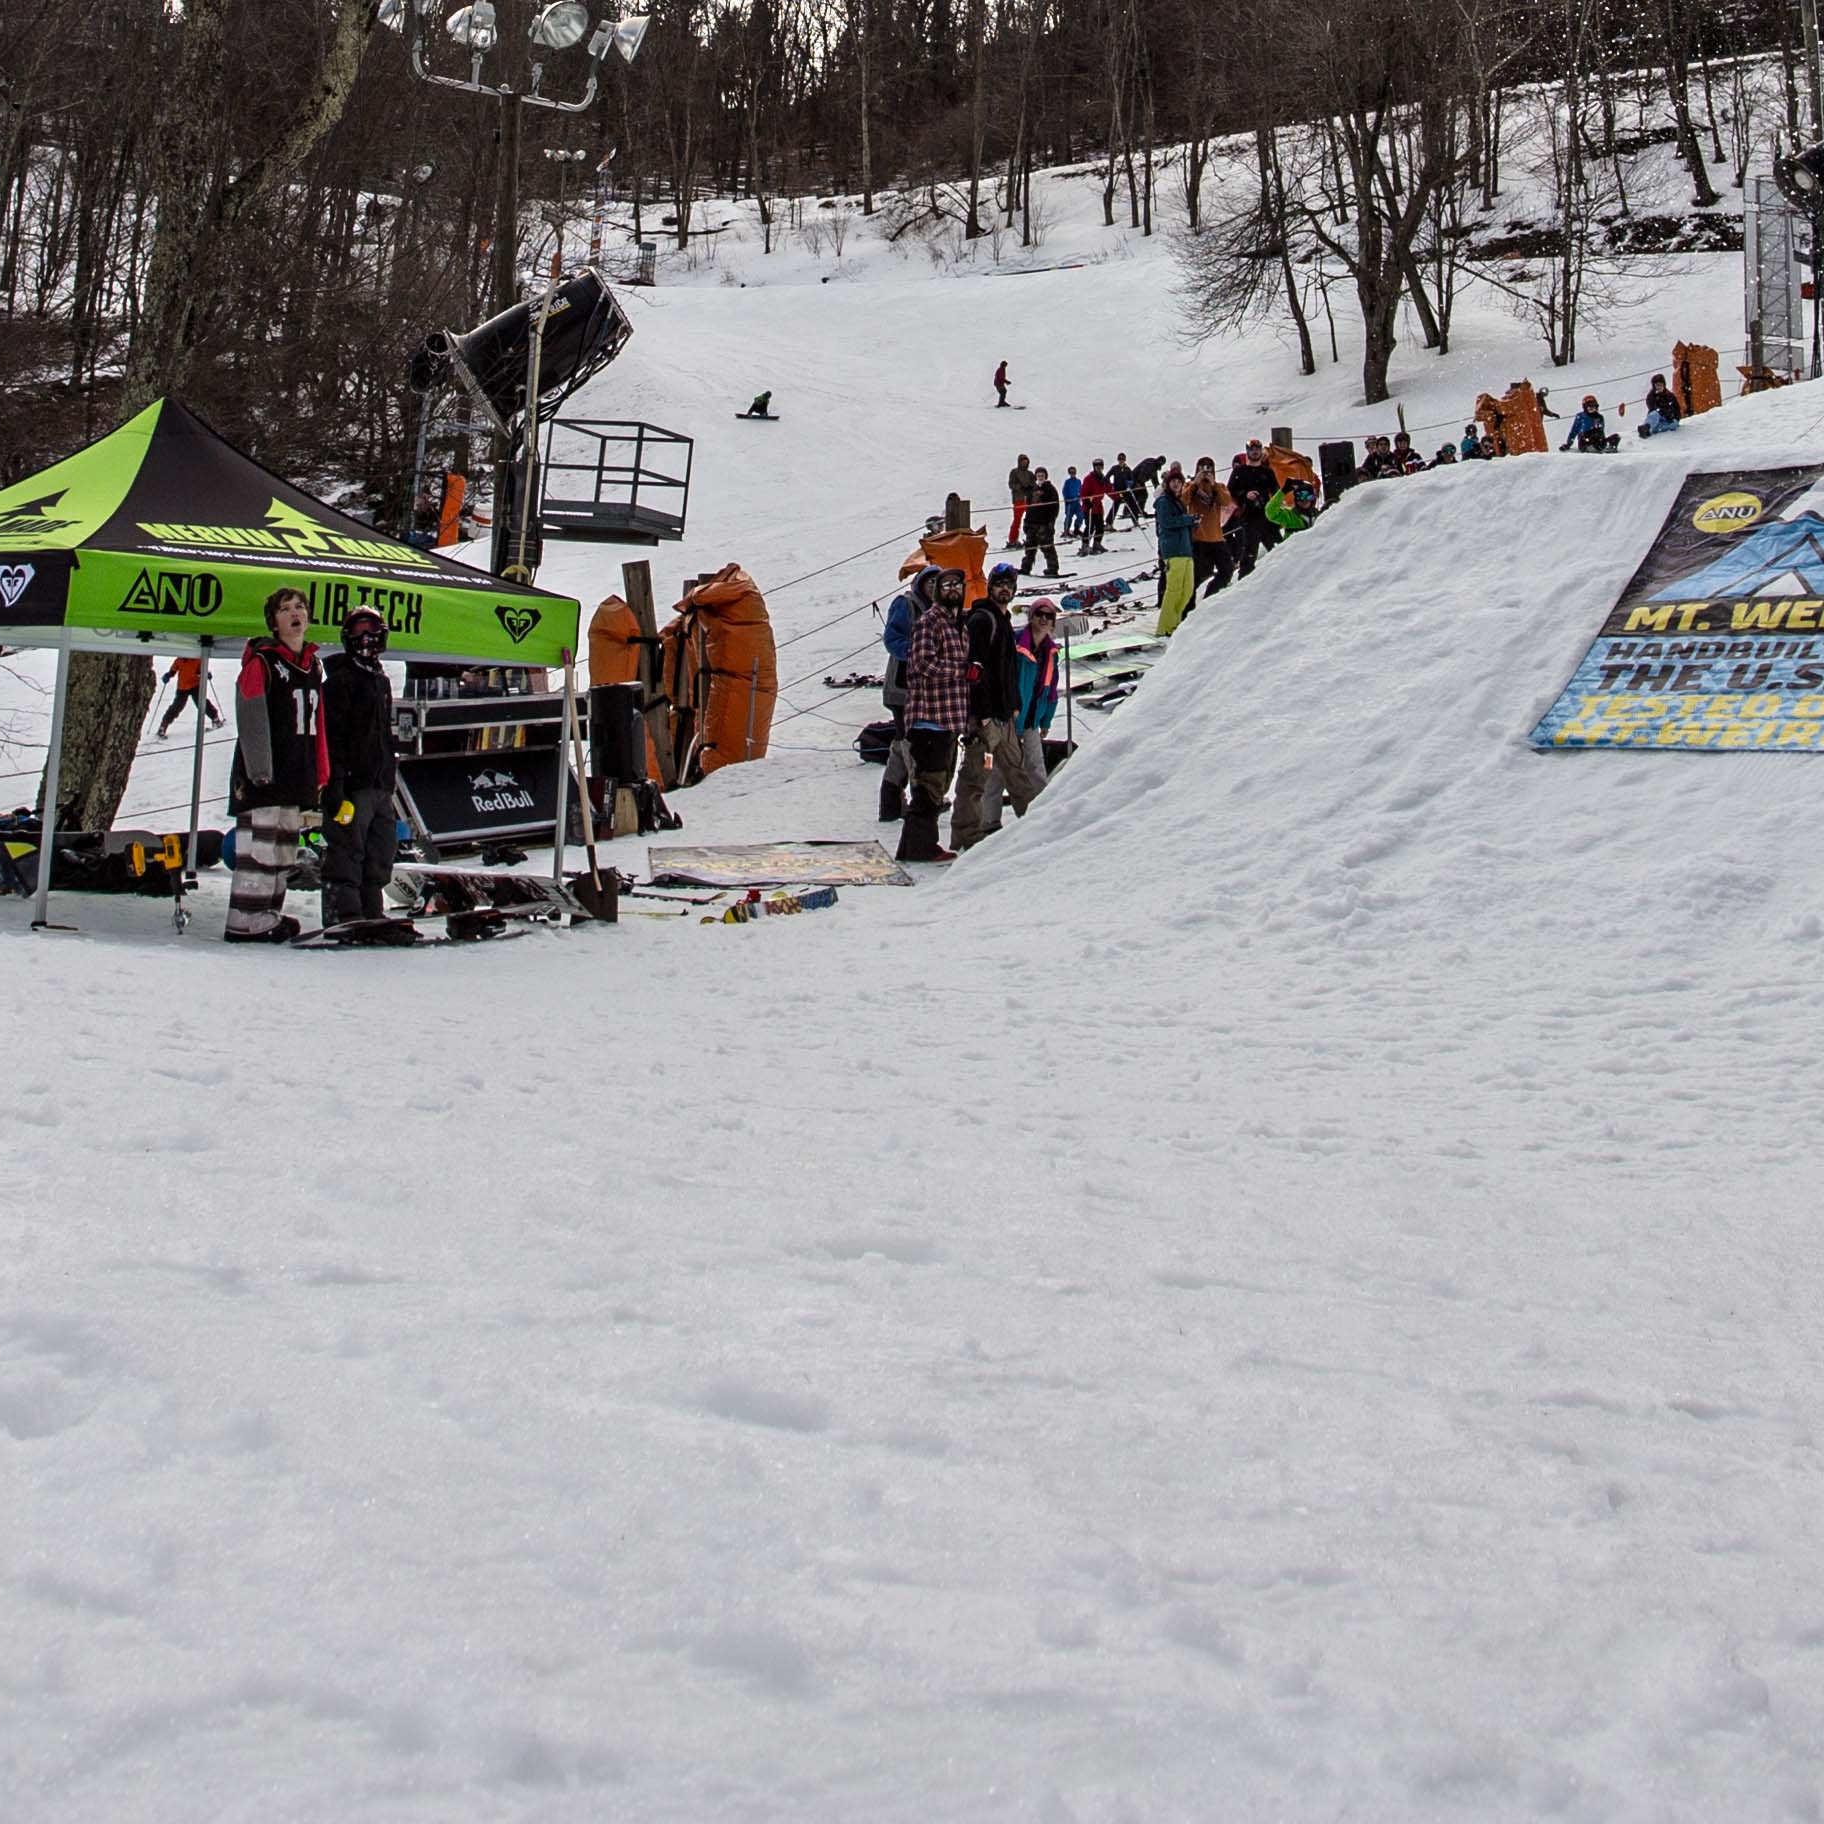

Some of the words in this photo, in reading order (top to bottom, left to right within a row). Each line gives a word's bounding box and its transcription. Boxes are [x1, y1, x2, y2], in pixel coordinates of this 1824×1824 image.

[136, 523, 288, 549] MERVIN
[326, 536, 433, 565] MADE
[118, 567, 224, 617] GNU
[308, 580, 350, 627] LIB
[1622, 602, 1710, 632] MT.
[1596, 664, 1712, 692] THE
[291, 688, 318, 736] 12
[1576, 695, 1791, 721] TESTED
[472, 793, 506, 813] Red
[506, 790, 535, 811] Bull
